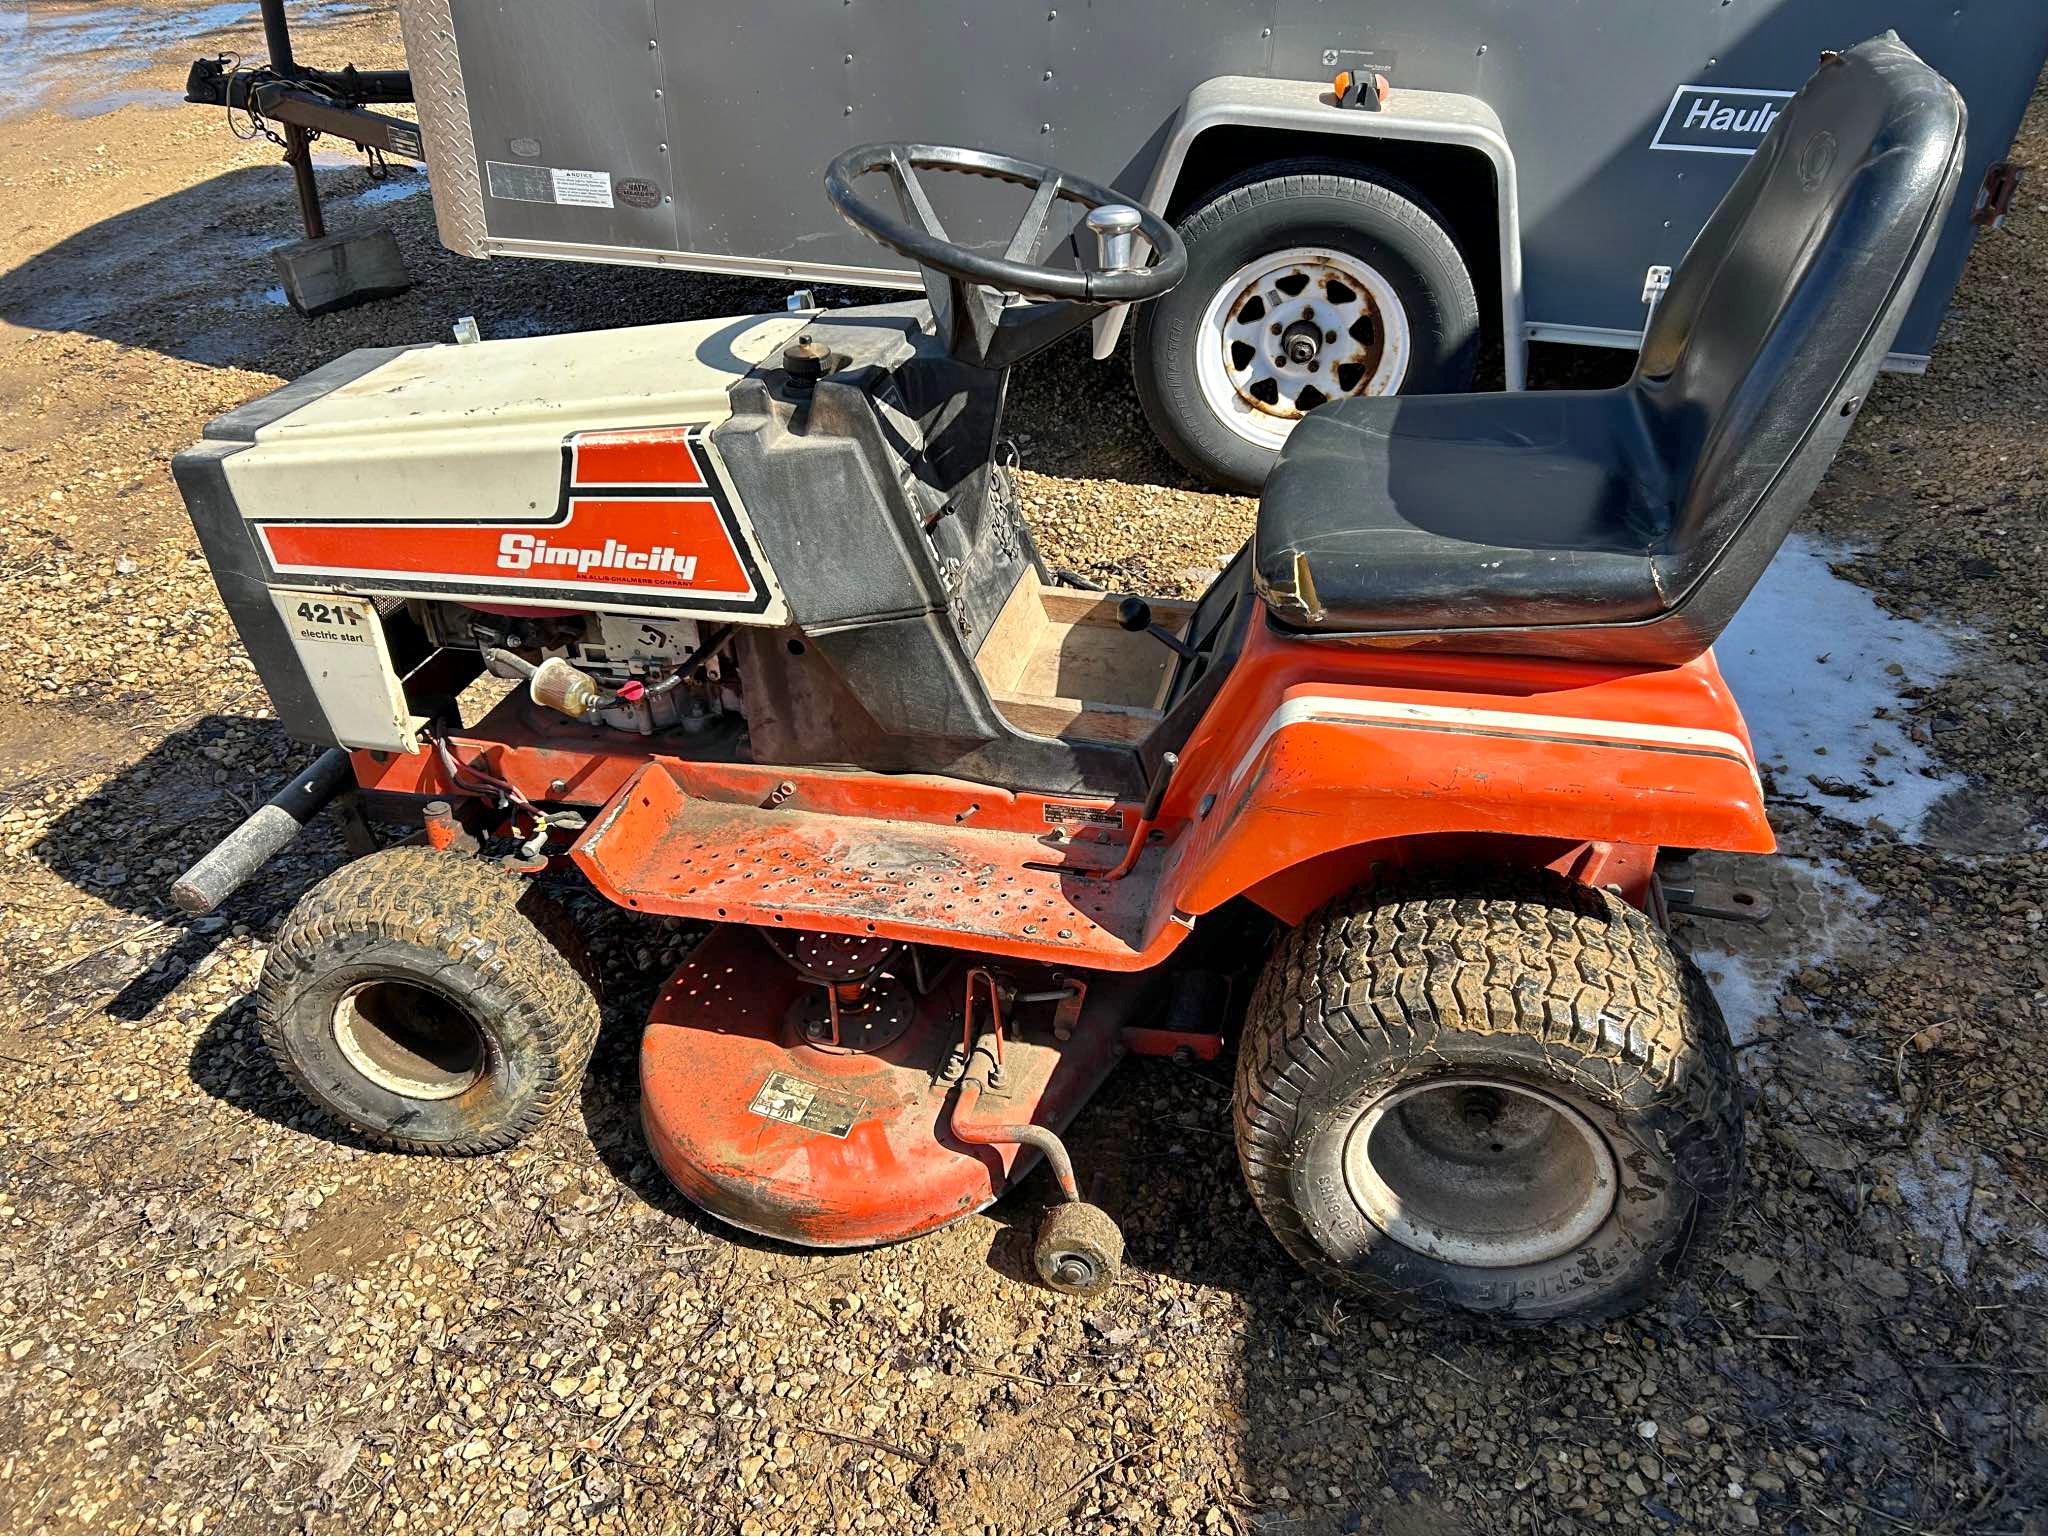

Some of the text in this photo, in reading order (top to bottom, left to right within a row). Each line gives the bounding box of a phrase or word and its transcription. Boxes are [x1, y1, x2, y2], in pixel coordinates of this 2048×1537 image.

[496, 533, 698, 581] Simplicity
[654, 579, 694, 587] COMPANY
[301, 629, 364, 643] electric start
